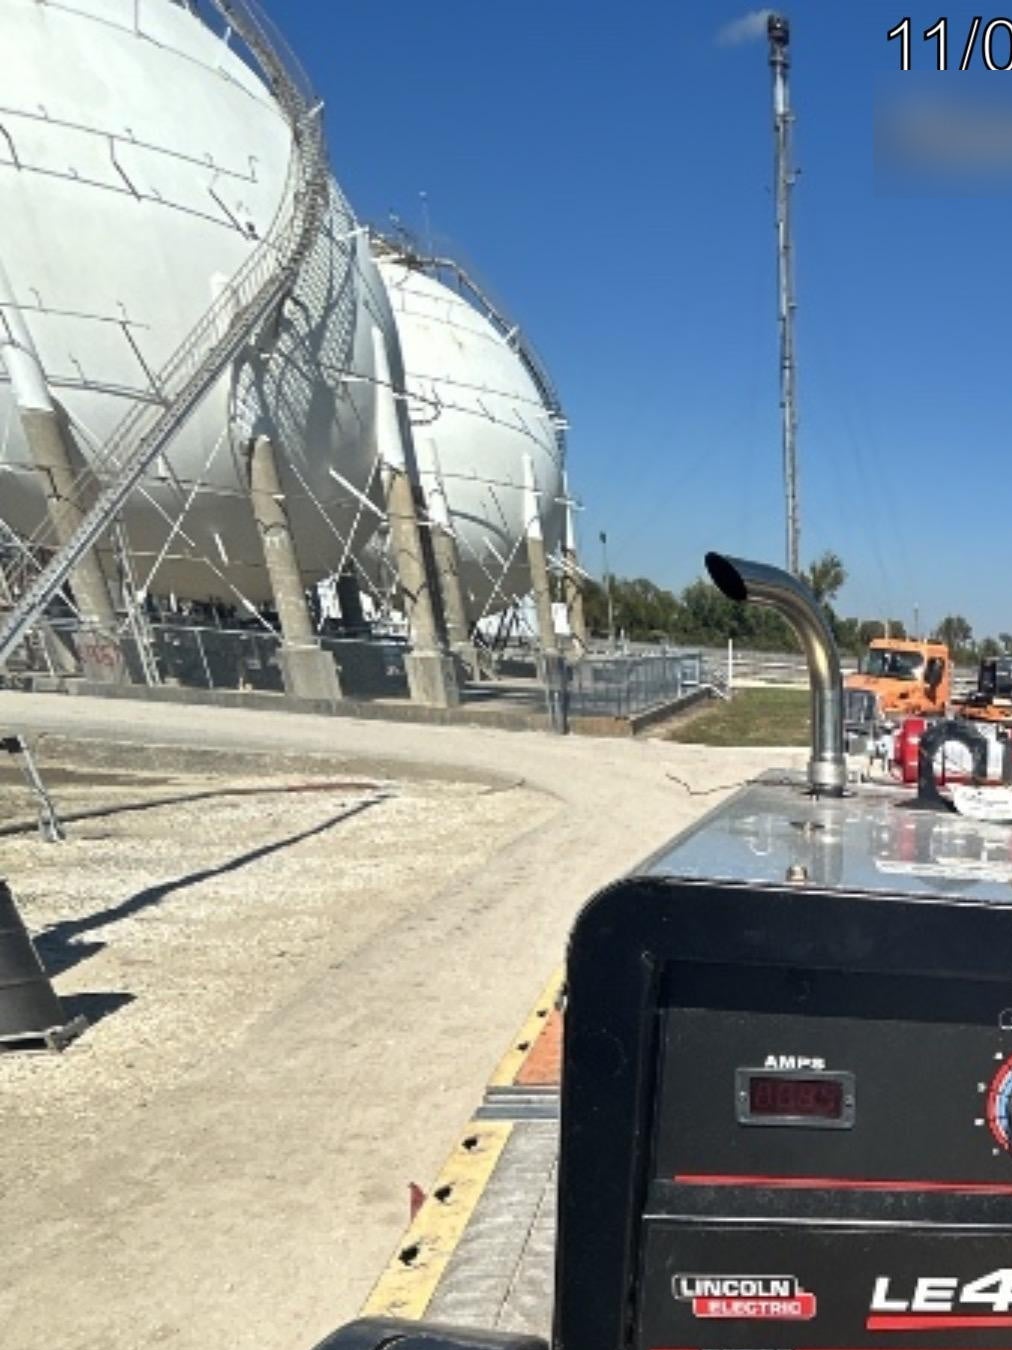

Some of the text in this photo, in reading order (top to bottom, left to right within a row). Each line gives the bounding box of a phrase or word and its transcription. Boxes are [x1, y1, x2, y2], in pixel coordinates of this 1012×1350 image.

[764, 1054, 827, 1070] AMPS
[680, 1277, 790, 1297] LINCOLN
[707, 1301, 803, 1315] ELECTRIC
